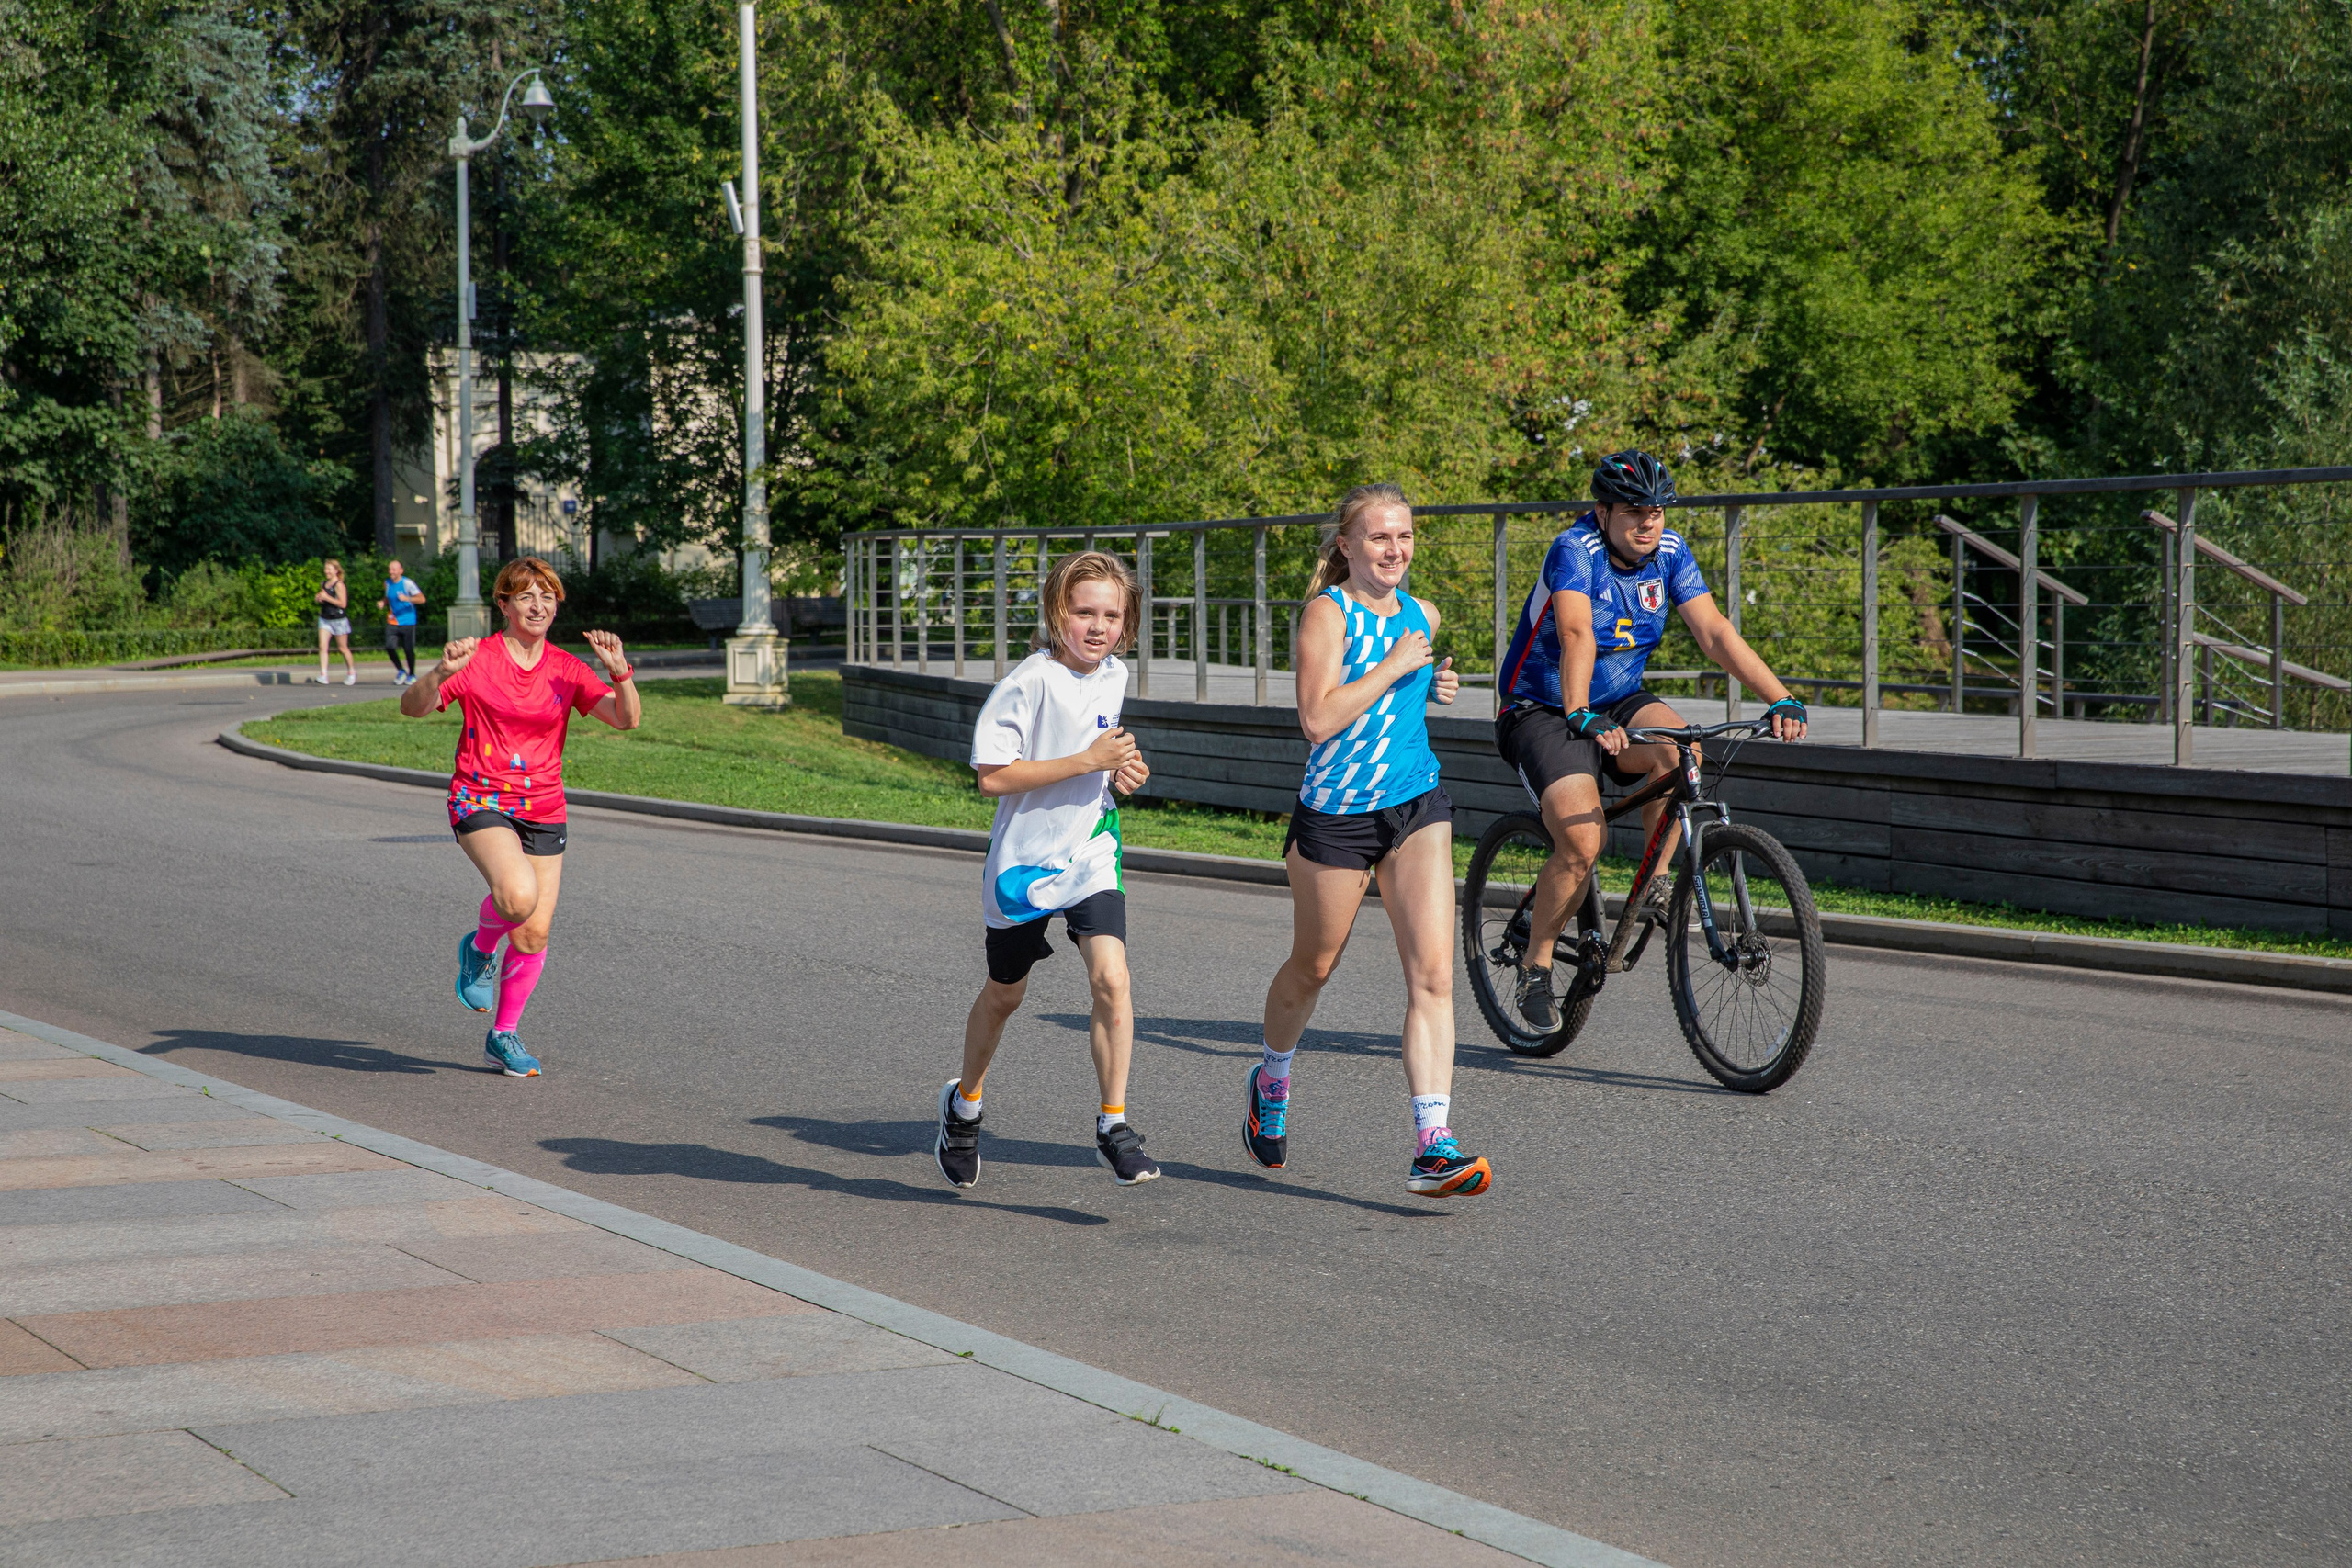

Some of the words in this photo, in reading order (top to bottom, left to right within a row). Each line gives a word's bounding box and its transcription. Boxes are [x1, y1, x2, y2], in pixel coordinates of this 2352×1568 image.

[1614, 618, 1635, 651] 5
[1698, 888, 1709, 918] SUNTOUR
[1509, 1034, 1532, 1047] PATROL
